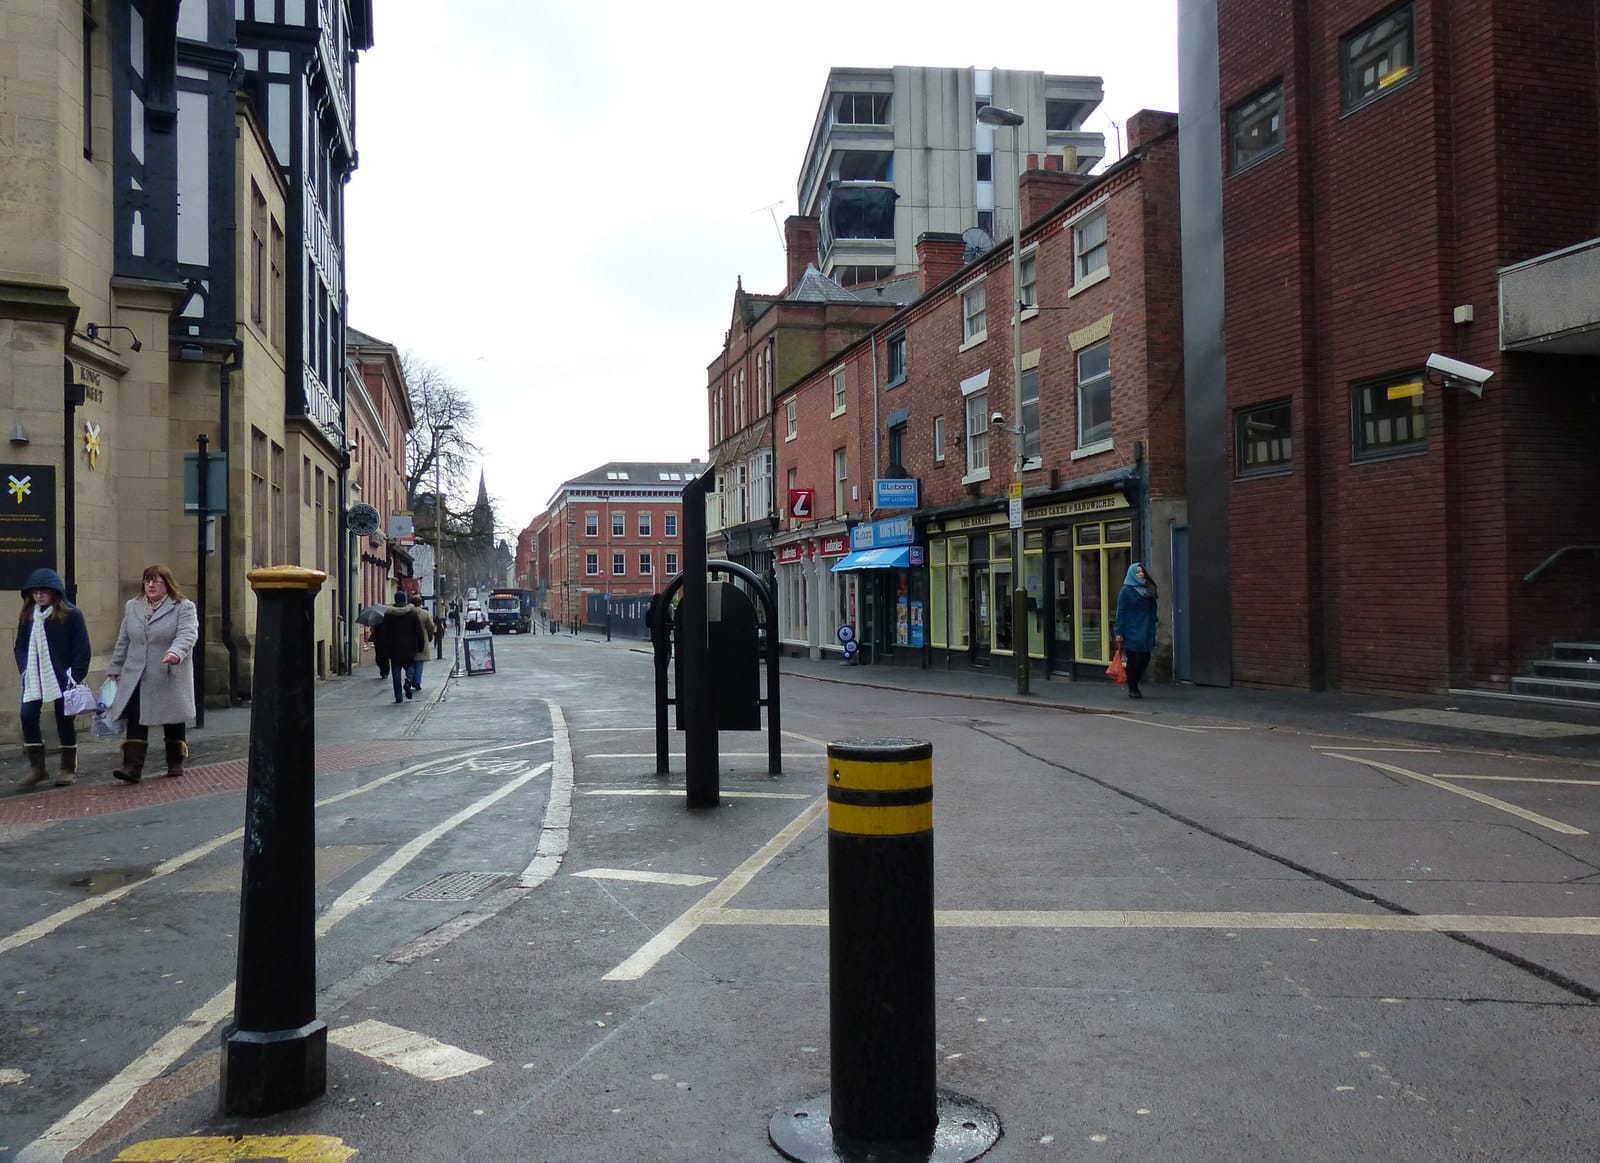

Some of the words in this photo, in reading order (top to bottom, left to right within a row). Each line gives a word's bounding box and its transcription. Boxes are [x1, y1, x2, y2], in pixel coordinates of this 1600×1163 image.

[80, 366, 101, 387] KING
[886, 483, 913, 491] Lebara
[1073, 497, 1116, 512] SANDWICHES
